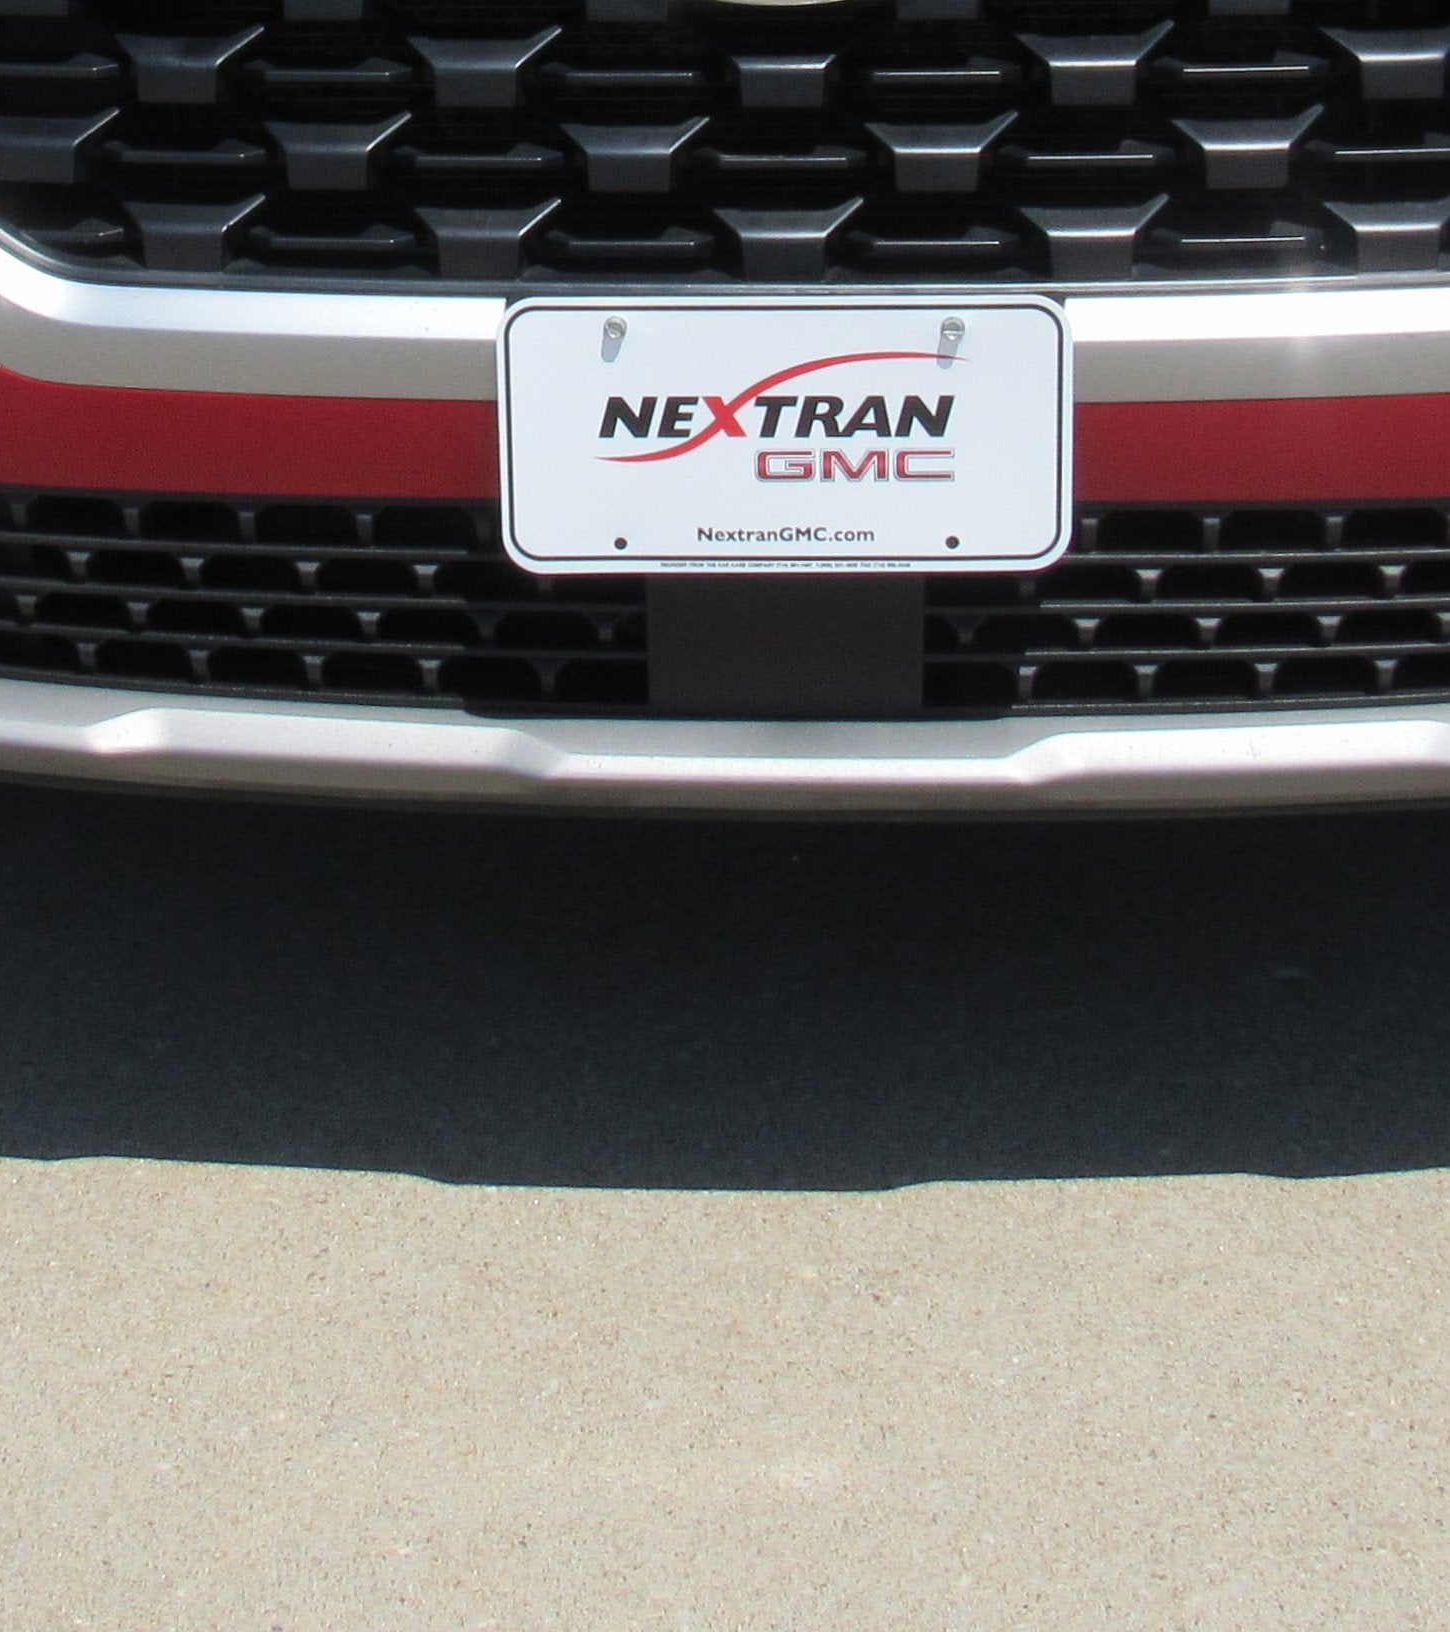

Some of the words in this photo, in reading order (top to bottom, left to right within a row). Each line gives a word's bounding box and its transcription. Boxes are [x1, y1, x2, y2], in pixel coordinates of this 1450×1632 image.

[598, 395, 955, 438] NEXTRAN
[754, 448, 955, 482] GMC
[697, 526, 875, 544] NextranGMC.com
